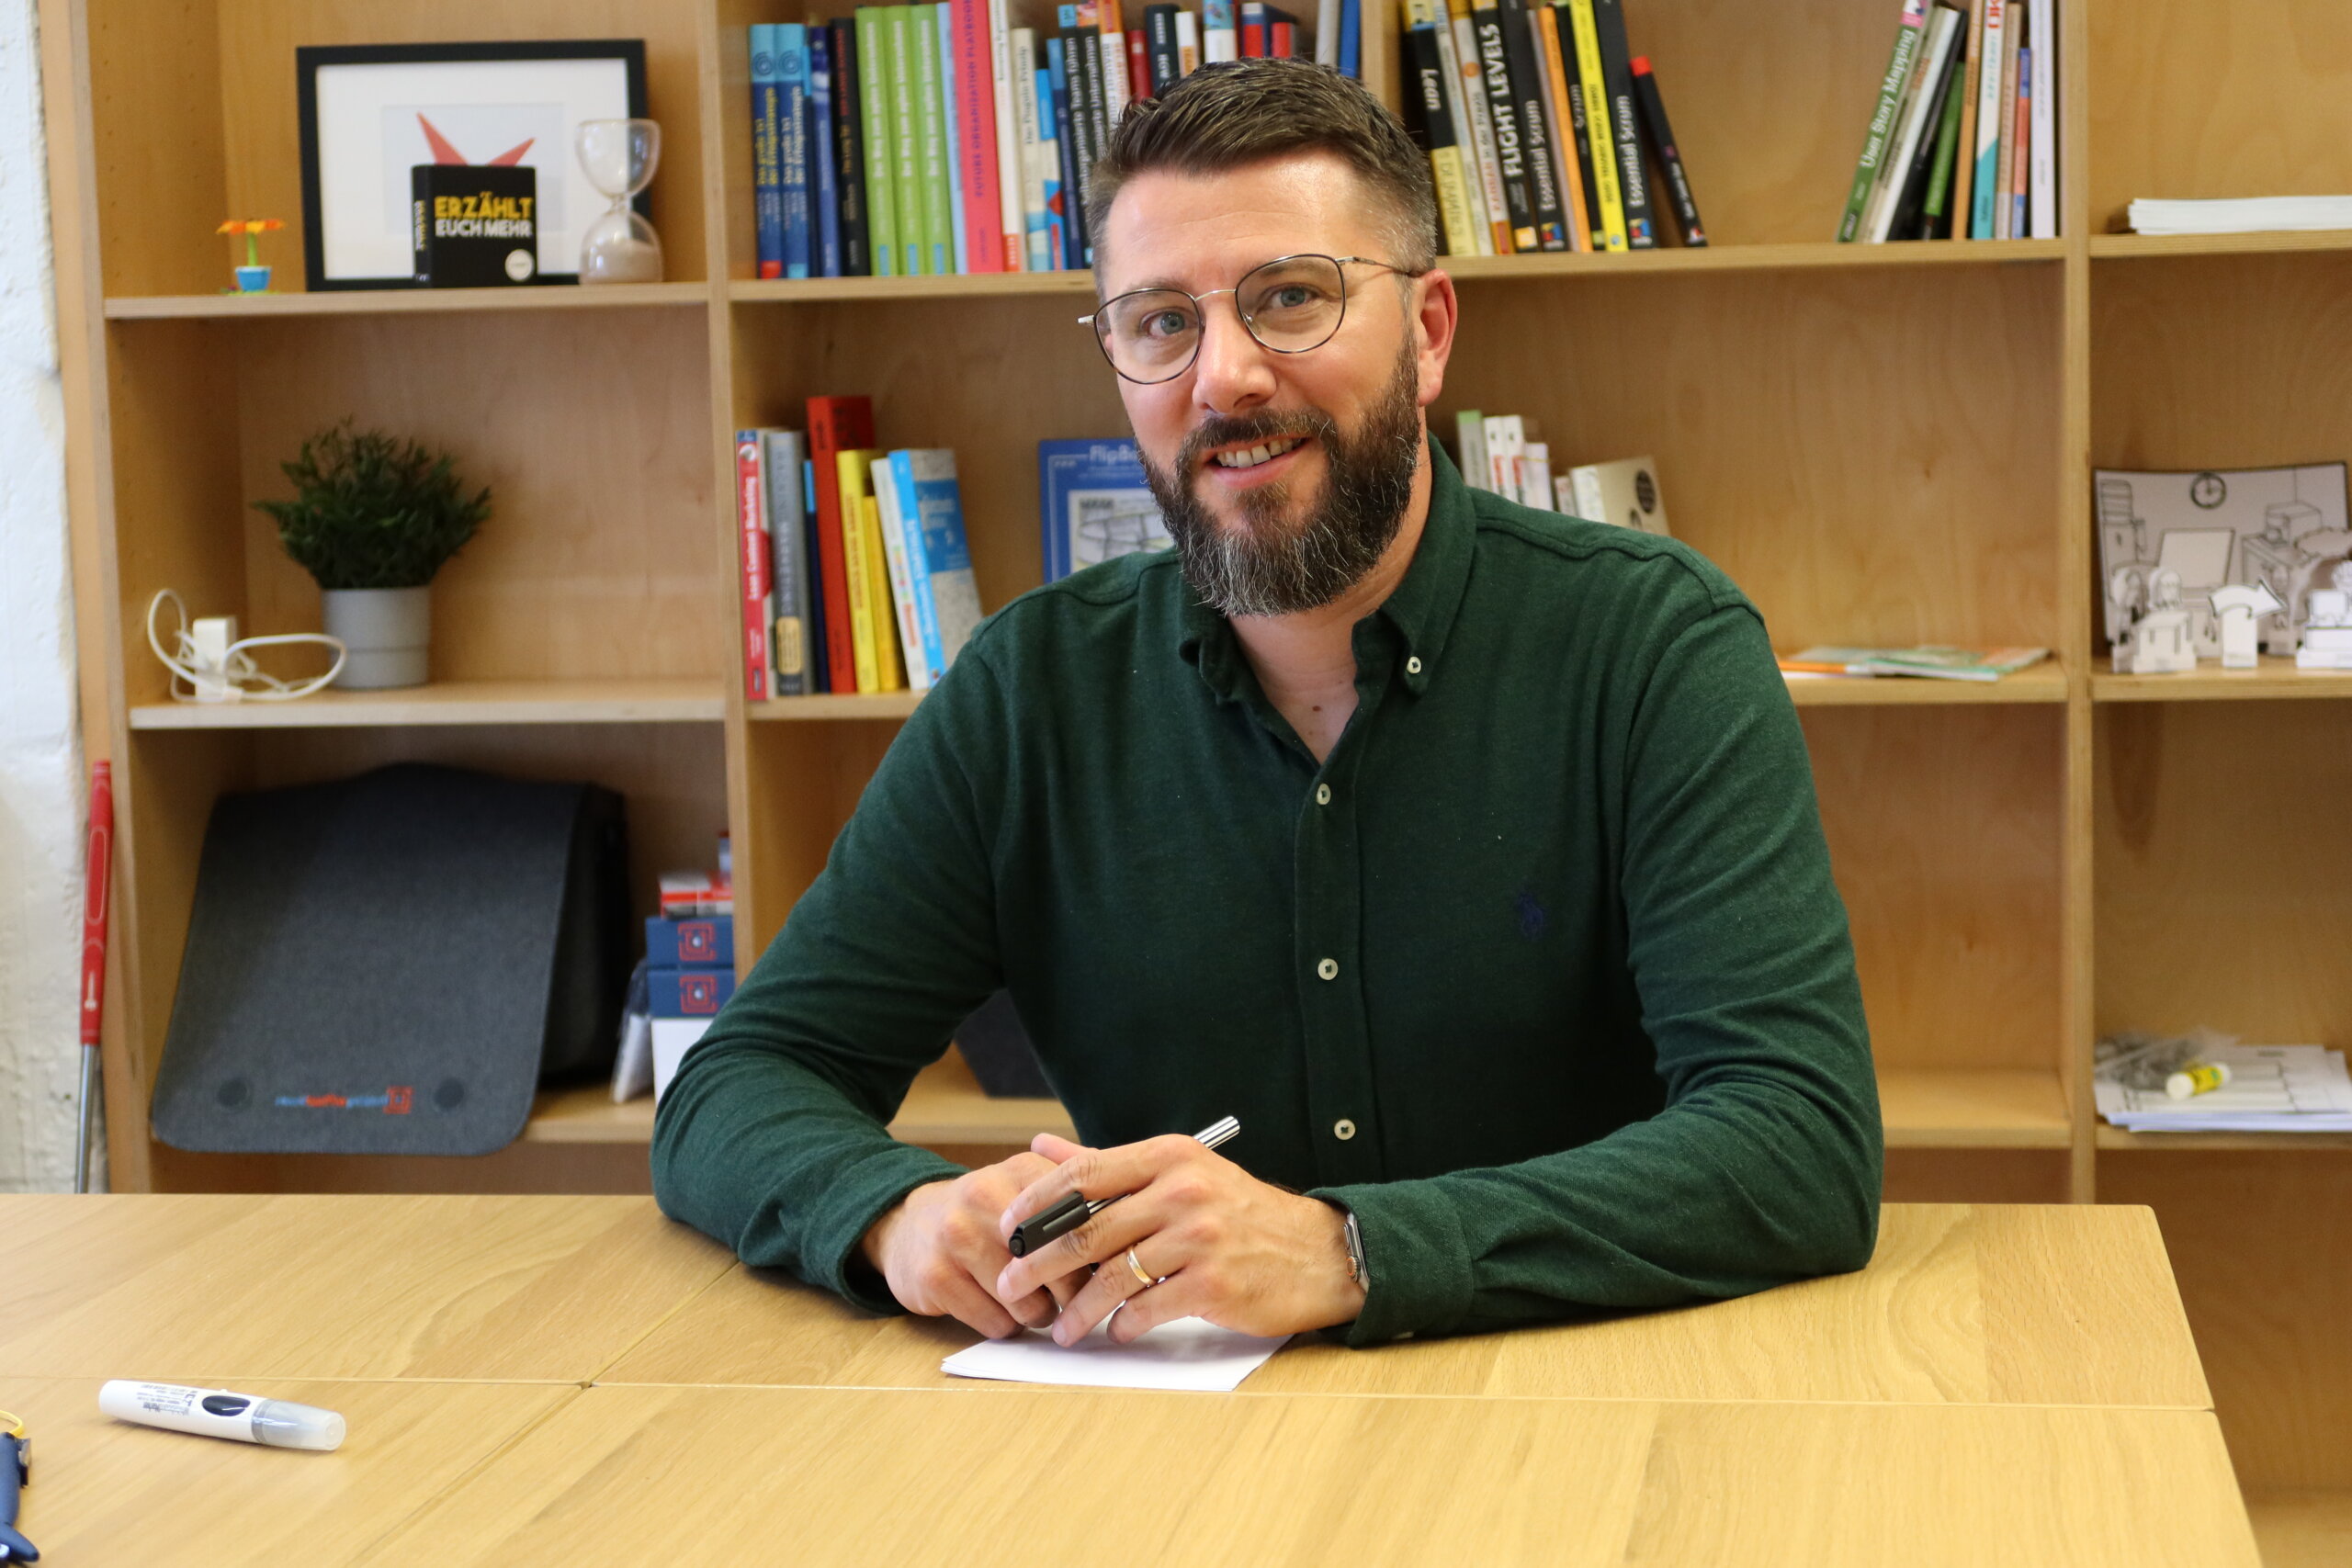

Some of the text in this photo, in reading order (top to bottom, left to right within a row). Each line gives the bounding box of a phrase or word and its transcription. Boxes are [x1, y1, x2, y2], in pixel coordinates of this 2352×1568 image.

[1064, 38, 1082, 74] führen
[1084, 36, 1100, 108] Unternehmen
[1477, 24, 1511, 97] LEVELS
[1882, 28, 1917, 93] Mapping
[966, 62, 982, 149] ORGANIZATION
[1069, 76, 1085, 110] Teams
[1420, 68, 1441, 111] Lean
[1524, 99, 1545, 145] Scrum
[1615, 96, 1637, 141] Scrum
[1870, 95, 1897, 135] Story
[1491, 103, 1525, 177] FLIGHT
[1859, 135, 1881, 169] User
[971, 152, 986, 197] FUTURE
[1529, 147, 1557, 211] Essential
[1618, 143, 1645, 207] Essential
[434, 191, 533, 219] ERZÄHLT
[435, 220, 533, 238] EUCH MEHR
